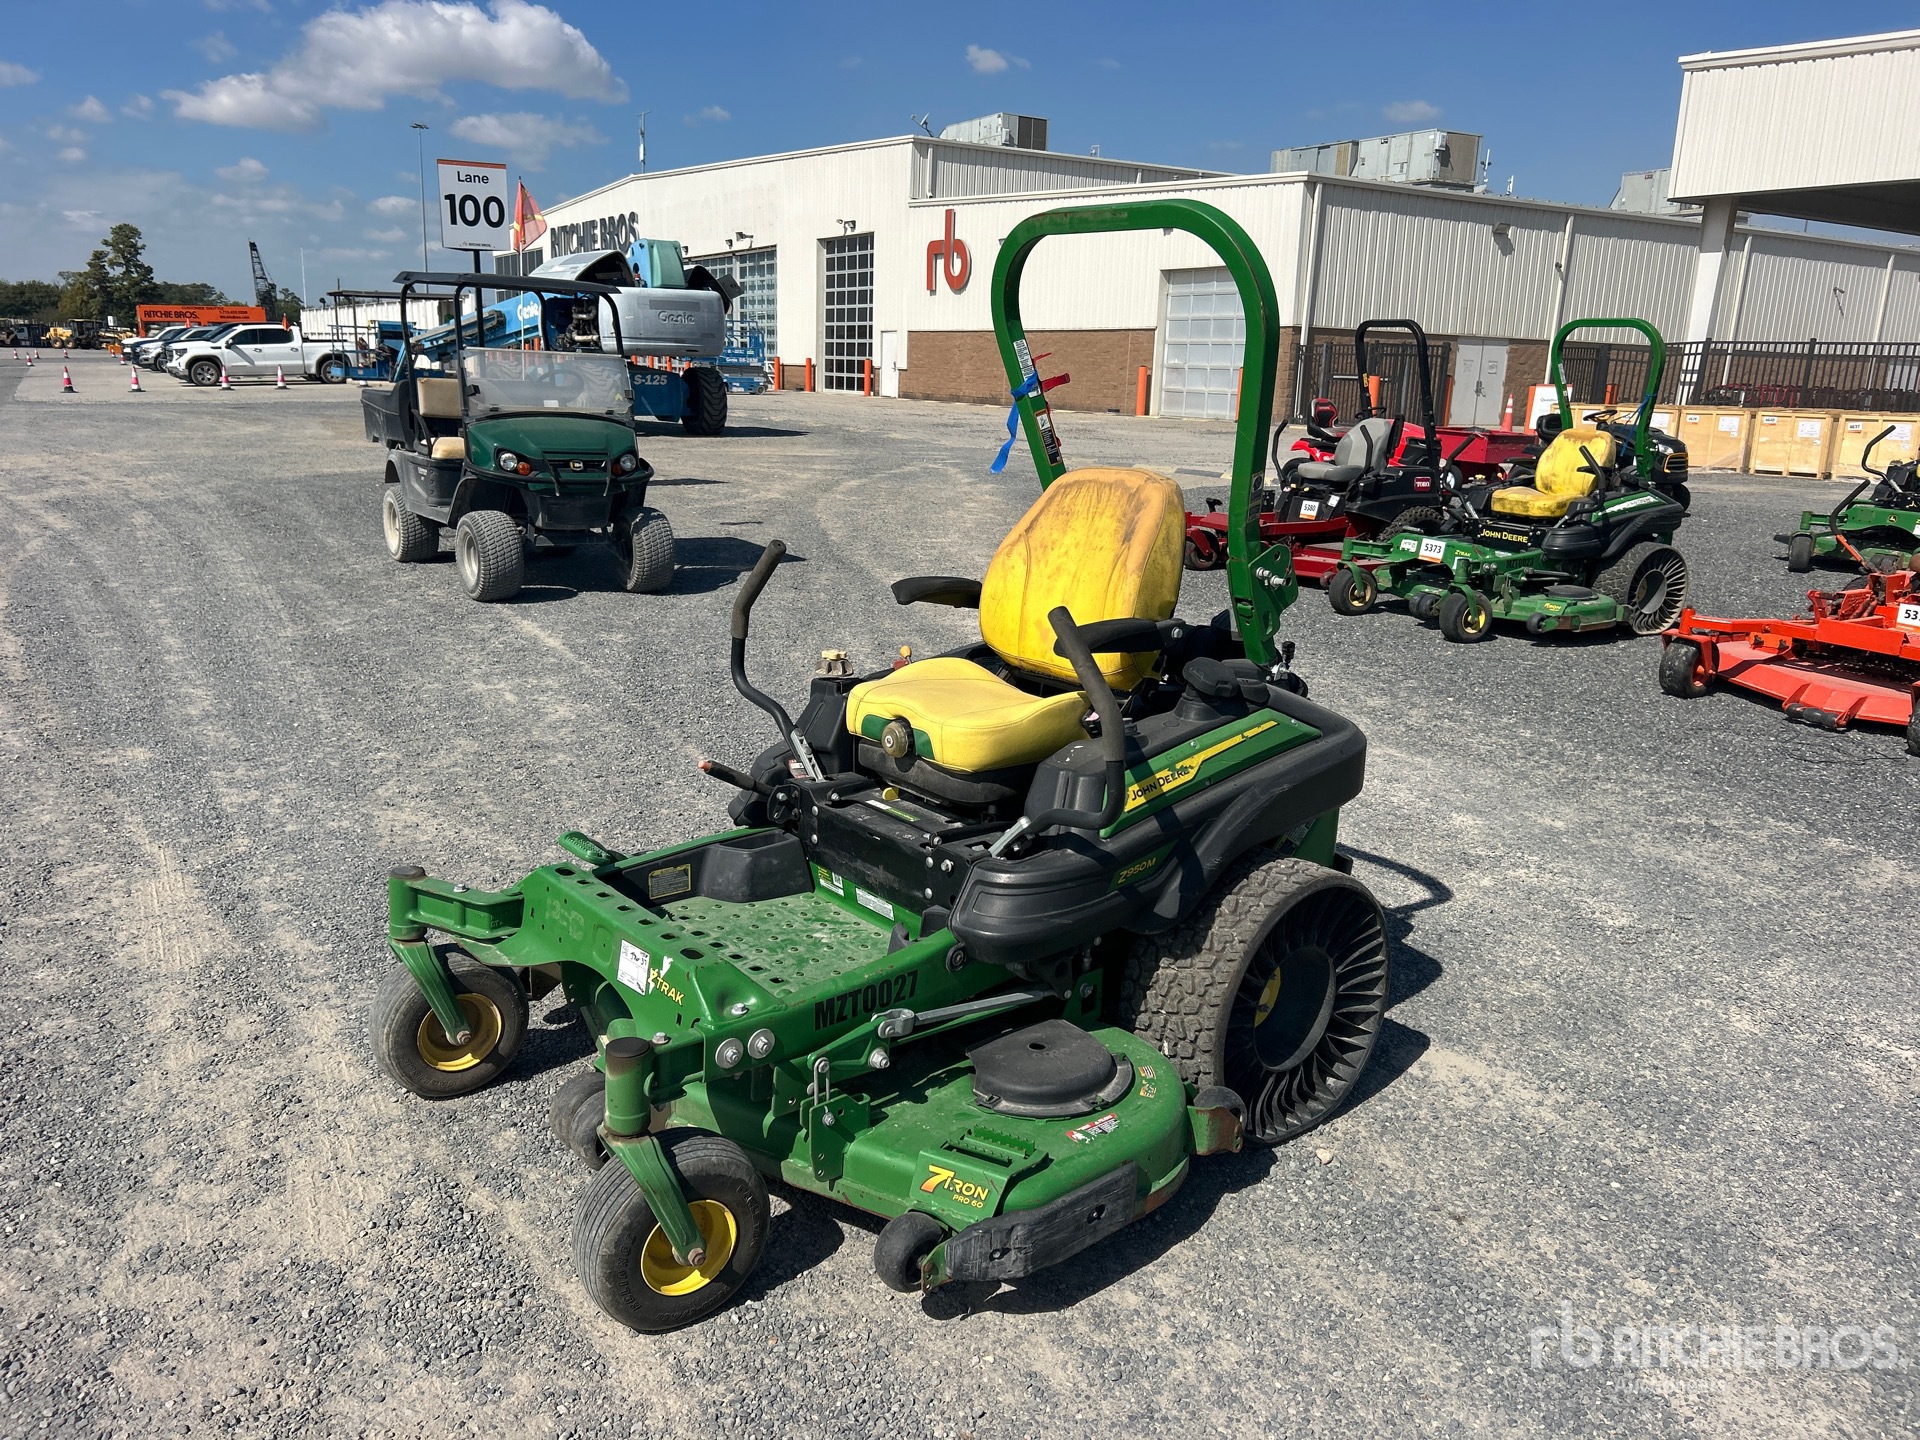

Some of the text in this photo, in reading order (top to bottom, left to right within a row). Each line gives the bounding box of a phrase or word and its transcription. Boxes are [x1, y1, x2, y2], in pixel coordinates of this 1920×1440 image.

[457, 170, 489, 184] Lane
[444, 193, 505, 229] 100
[550, 219, 598, 259] RITCHIE
[144, 310, 200, 319] RITCHIE BROS.
[657, 310, 696, 325] Genie
[633, 374, 668, 386] S-125
[1480, 528, 1529, 543] JOHN DEERE
[1424, 543, 1442, 554] 5373
[1904, 609, 1920, 621] 53
[1131, 782, 1157, 802] JOHN
[1117, 857, 1157, 884] Z950M
[814, 969, 919, 1031] MZT0027
[952, 1194, 985, 1209] PRO 60
